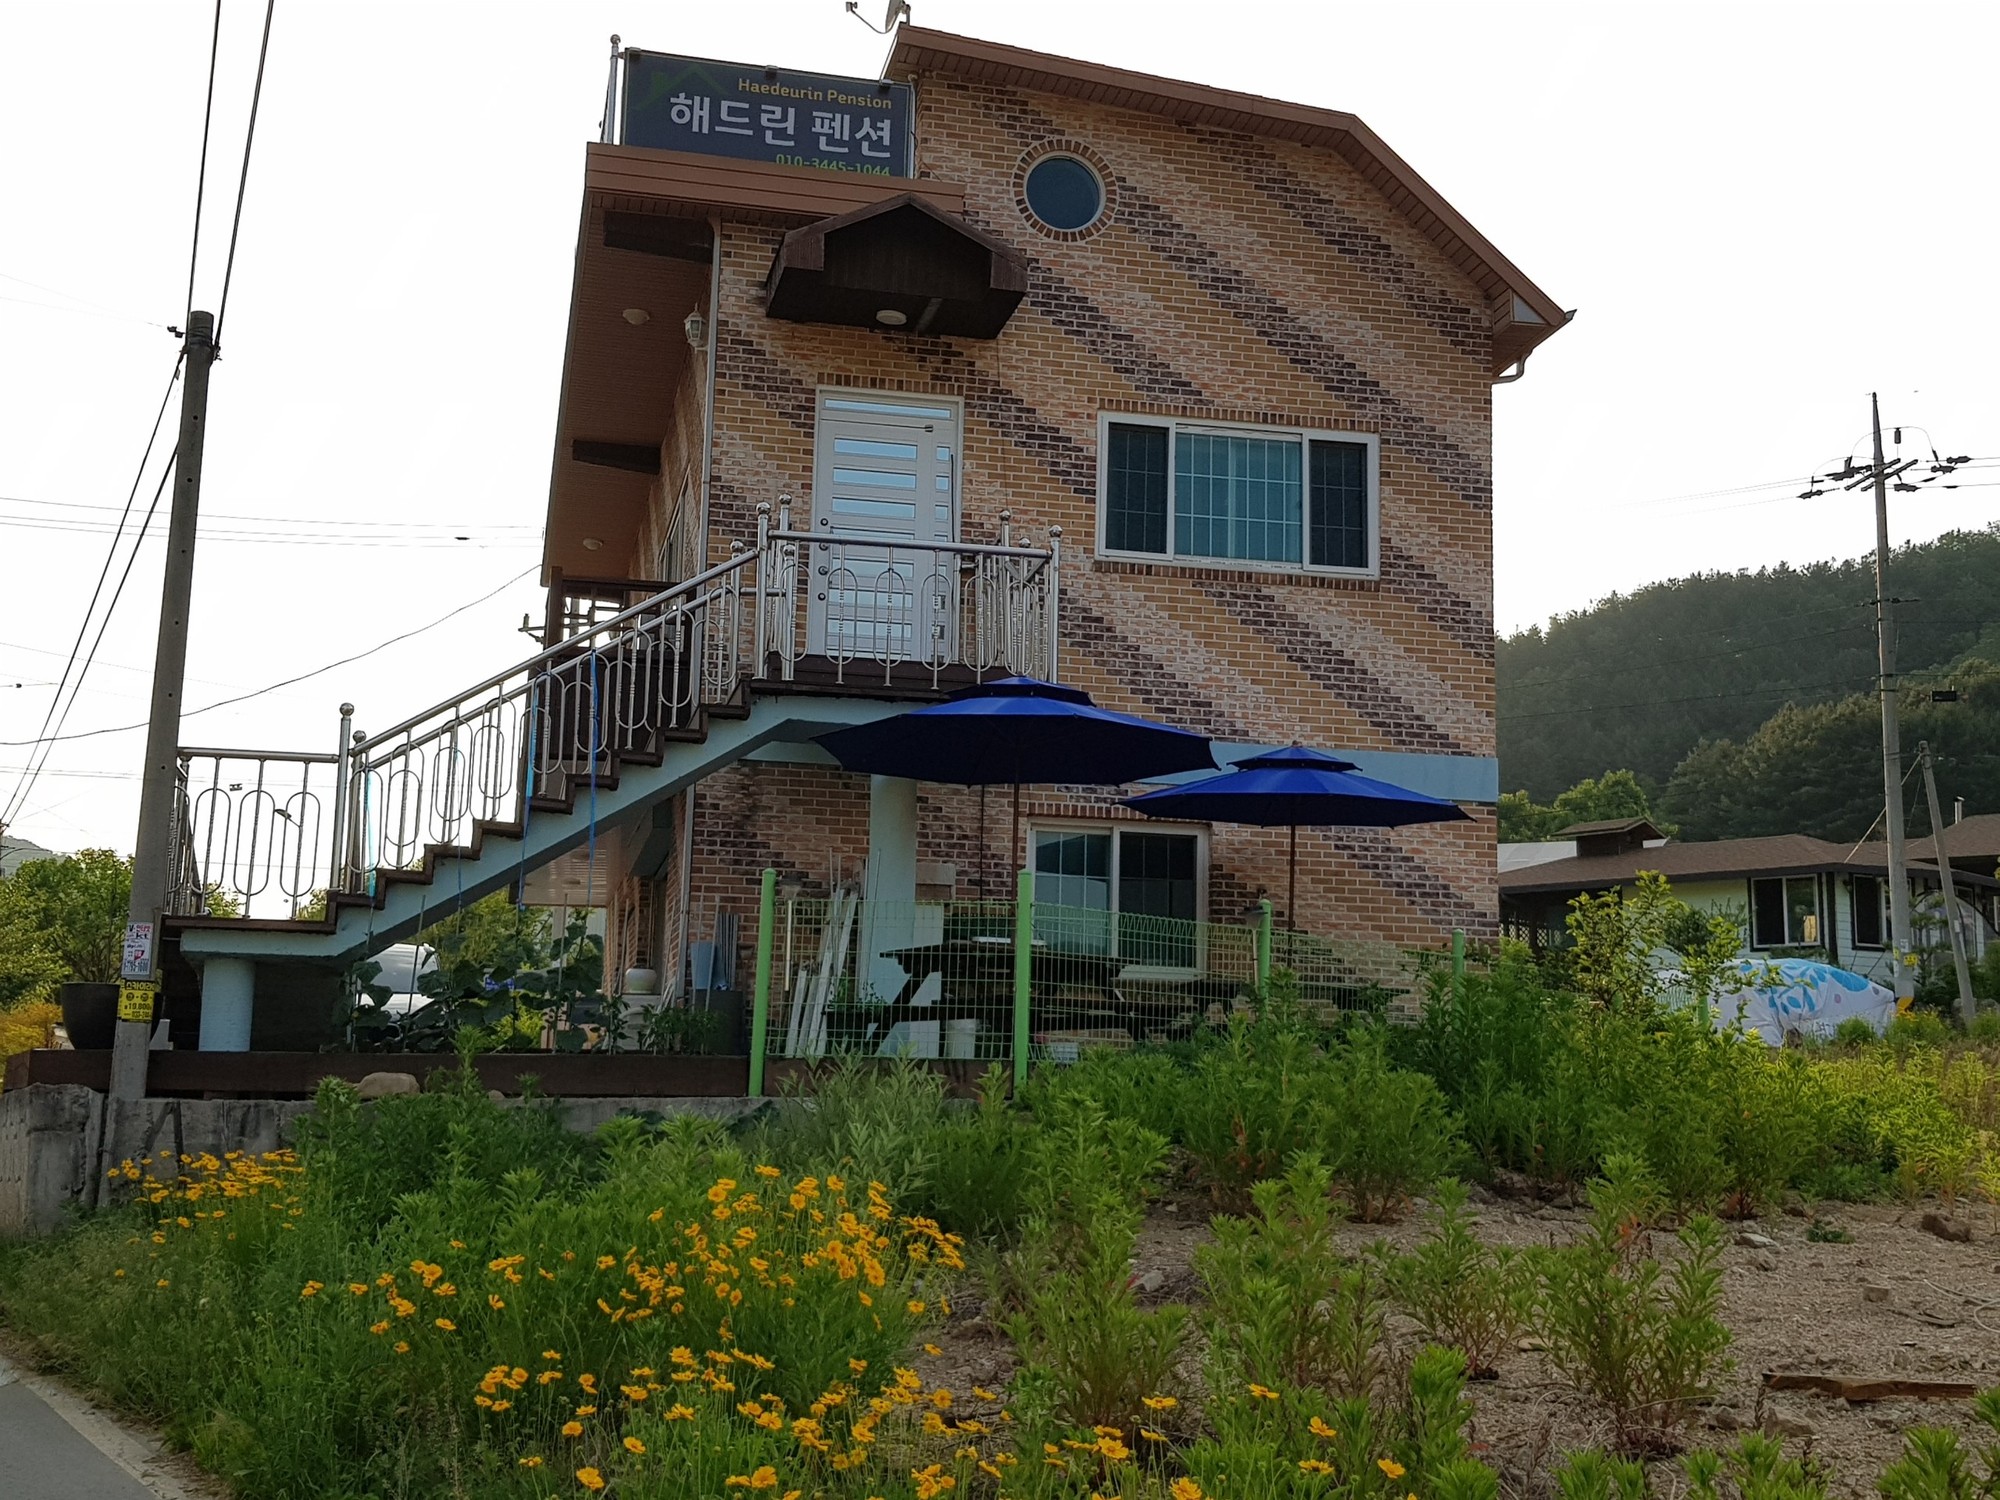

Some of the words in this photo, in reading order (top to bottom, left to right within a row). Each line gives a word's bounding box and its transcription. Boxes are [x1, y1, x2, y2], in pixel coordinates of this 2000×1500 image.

[738, 78, 823, 102] Haedeurin
[827, 90, 892, 110] Pension
[669, 92, 796, 147] 해드린
[811, 110, 891, 158] 펜션
